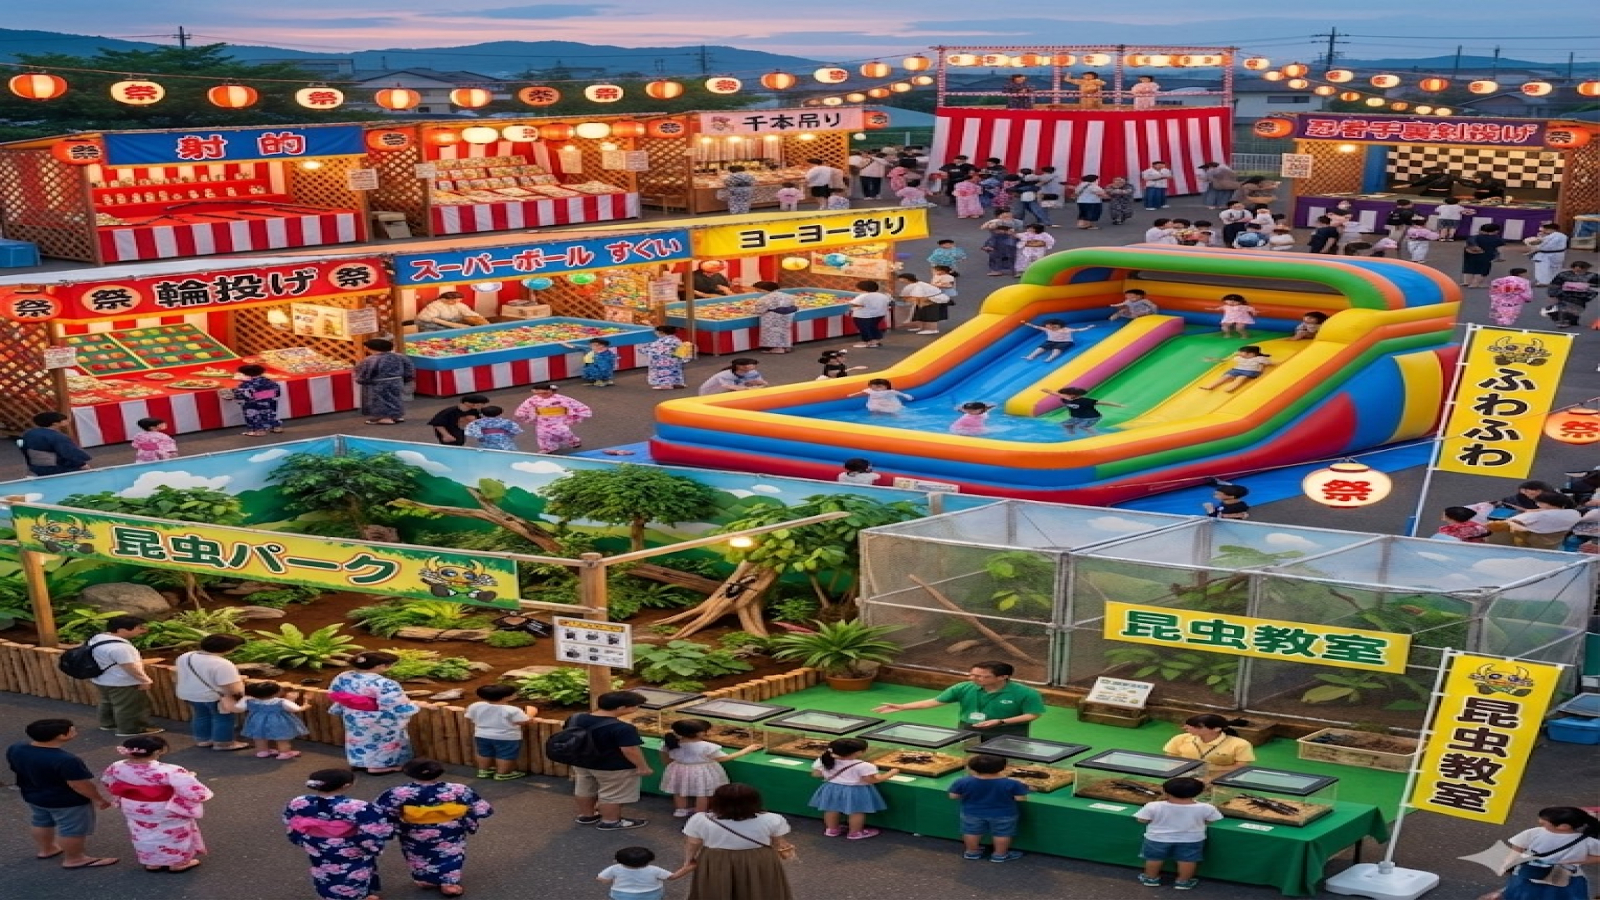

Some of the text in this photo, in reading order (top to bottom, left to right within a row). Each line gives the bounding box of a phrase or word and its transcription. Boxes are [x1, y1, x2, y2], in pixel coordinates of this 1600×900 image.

[125, 84, 158, 101] 祭
[309, 91, 338, 105] 祭
[528, 89, 553, 102] 祭
[743, 112, 840, 131] 千本吊り
[177, 132, 307, 160] 射的
[382, 133, 406, 146] 祭
[71, 145, 99, 160] 祭
[739, 216, 905, 249] ヨーヨー釣り
[410, 238, 682, 282] スーパーボール すくい
[155, 266, 318, 309] 輪投げ
[335, 266, 371, 288] 祭
[14, 299, 53, 317] 祭
[92, 288, 133, 311] 祭
[1459, 367, 1536, 468] ふわふわ
[1321, 479, 1374, 501] 祭
[112, 526, 400, 584] 昆虫パーク
[1121, 610, 1388, 665] 昆虫教室
[1431, 697, 1520, 812] 昆虫教室
